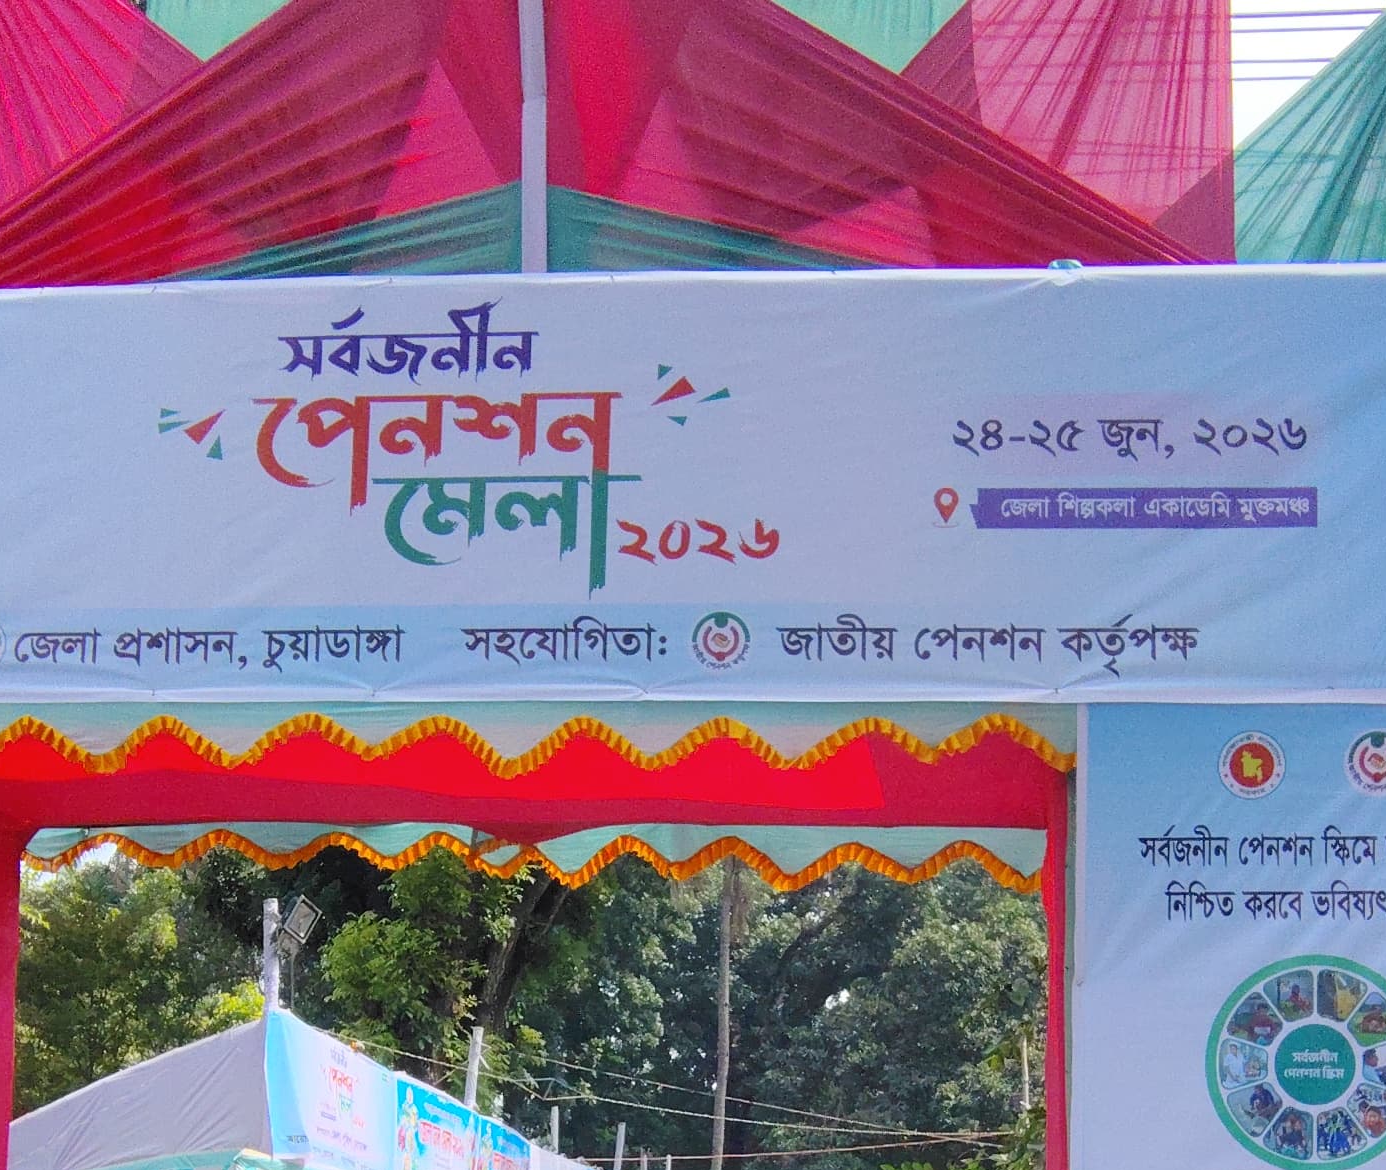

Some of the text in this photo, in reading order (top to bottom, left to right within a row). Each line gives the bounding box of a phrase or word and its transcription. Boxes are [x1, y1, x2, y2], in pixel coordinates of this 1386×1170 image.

[278, 296, 539, 384] সর্বজনীন
[251, 391, 621, 517] পেনশন
[952, 417, 1308, 460] ২৪-২৫ জুন, ২০২৬
[1000, 491, 1311, 524] জেলা শিল্পকলা একাডেমি মুক্তমঞ্চ
[372, 472, 780, 600] মেলা ২০২৬
[14, 628, 102, 667] জেলা
[112, 628, 248, 671] প্রশাসন,
[262, 628, 405, 673] চুয়াডাঙ্গা
[775, 616, 899, 663] জাতীয়
[914, 622, 1046, 663] পেনশন
[1057, 615, 1200, 678] কর্তৃপক্ষ
[1138, 824, 1229, 866] সর্বজনীন
[1238, 832, 1315, 866] পেনশন
[1321, 824, 1376, 866] স্কিমে
[1165, 879, 1235, 921] নিশ্চিত
[1243, 889, 1304, 921] করবে
